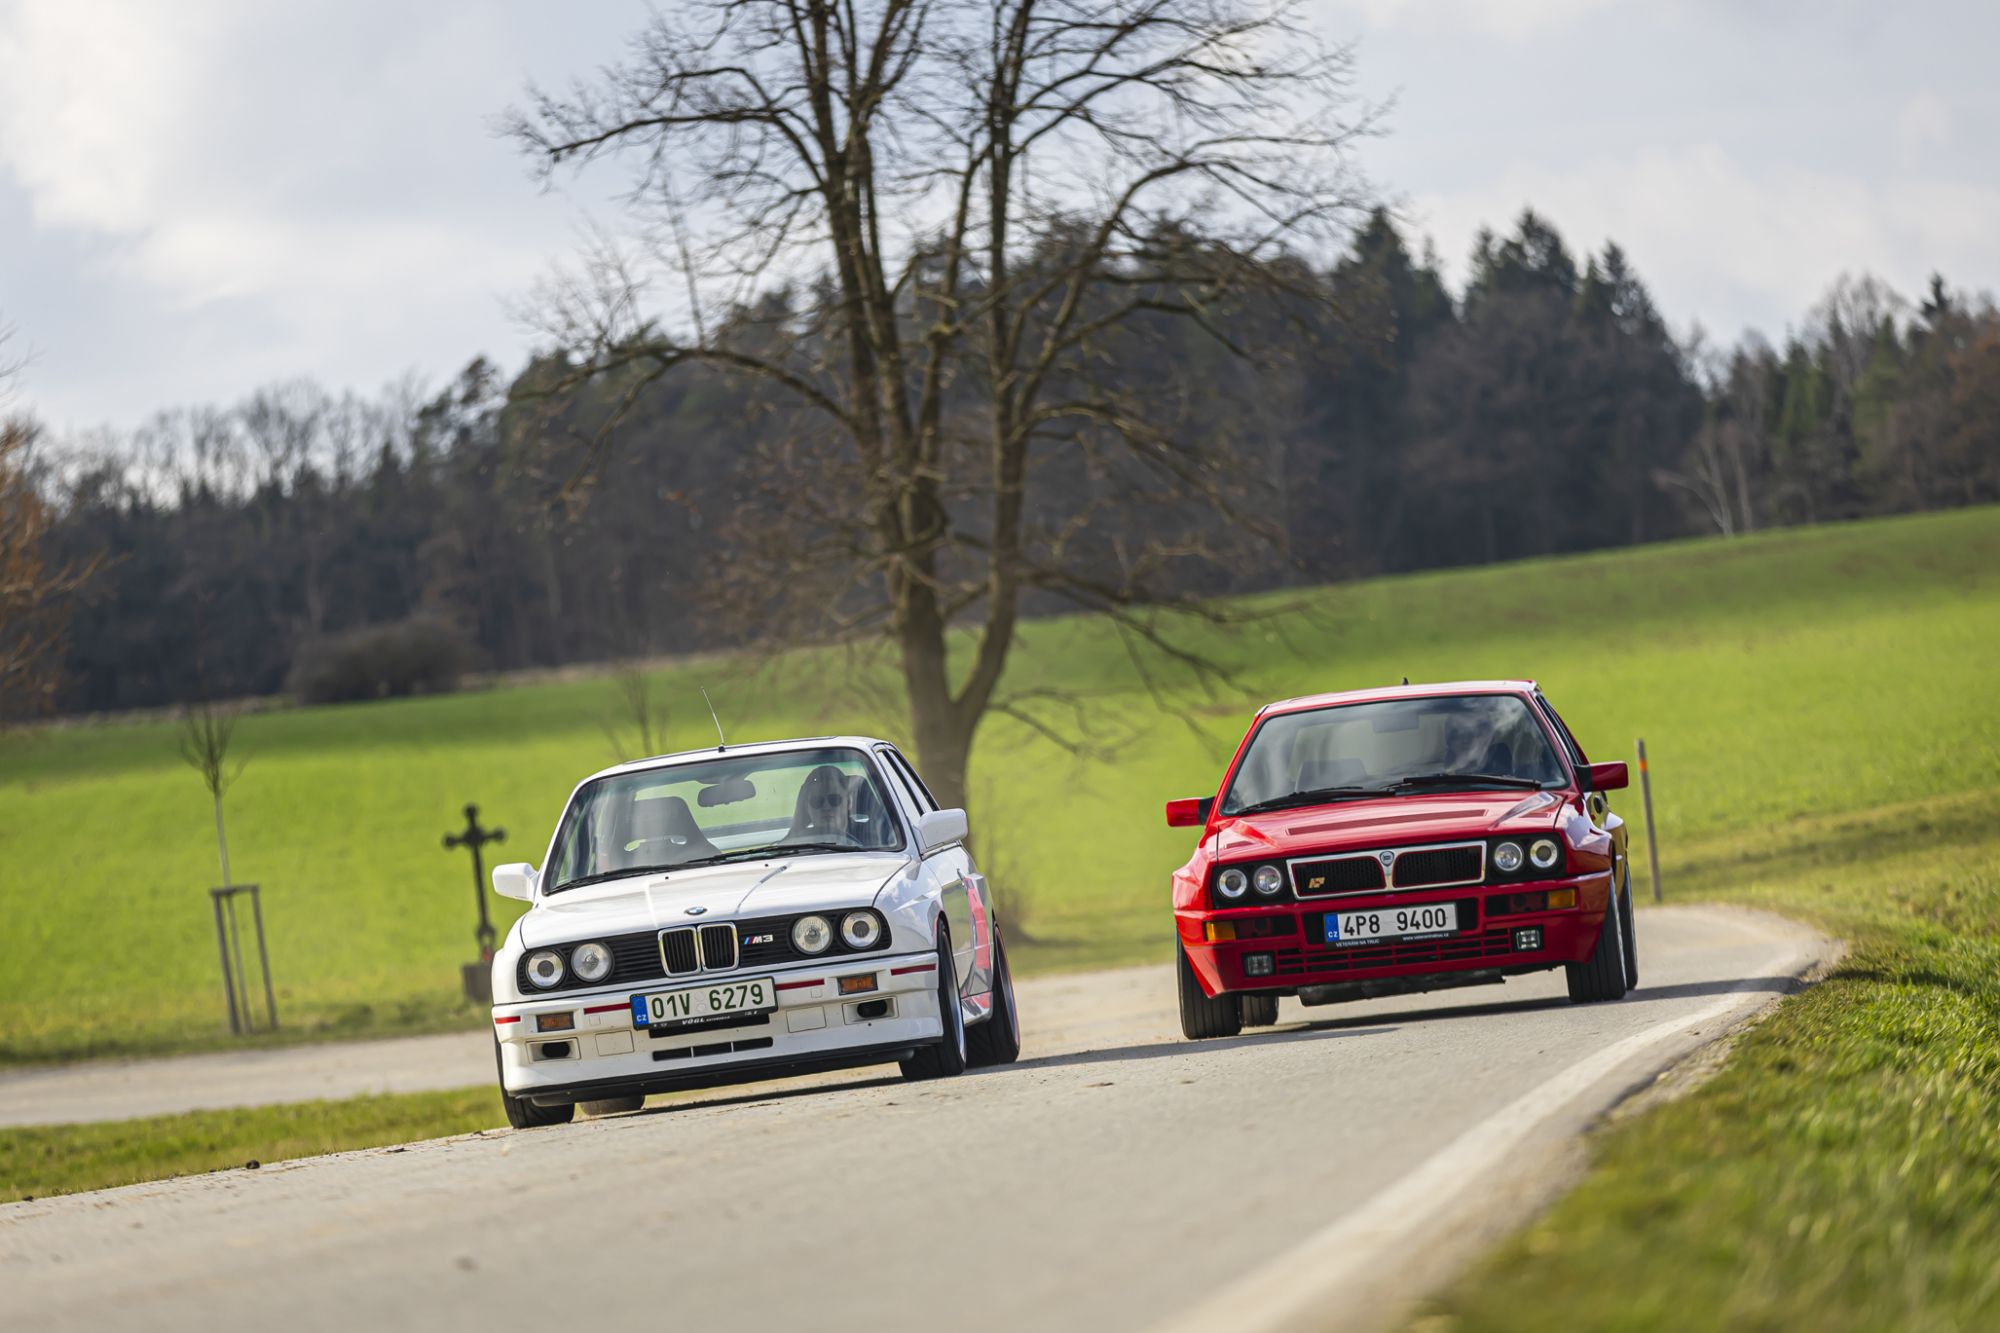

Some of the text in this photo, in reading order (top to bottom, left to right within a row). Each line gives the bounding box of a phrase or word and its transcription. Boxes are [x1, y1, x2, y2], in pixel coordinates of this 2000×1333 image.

[1343, 914, 1380, 937] 4P8
[1396, 908, 1447, 932] 9400
[751, 934, 774, 945] M3
[651, 983, 764, 1019] 01V 6279
[636, 1014, 647, 1022] CZ
